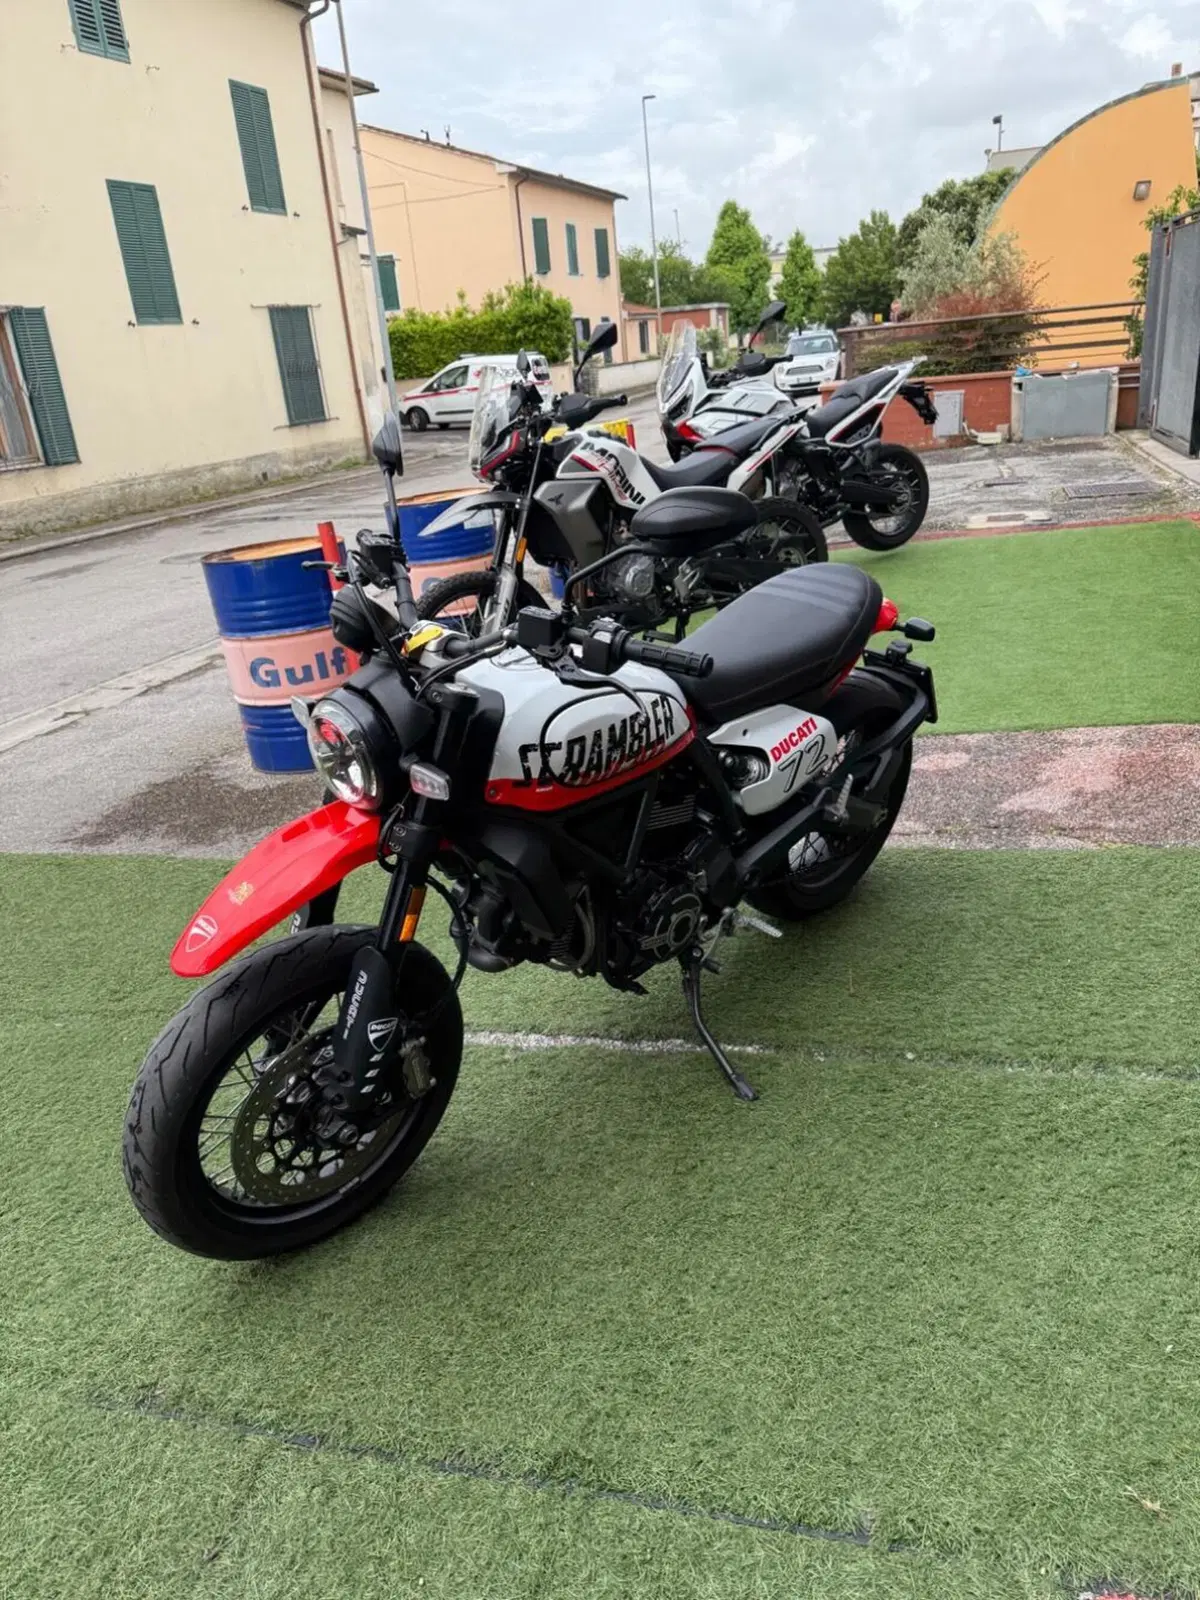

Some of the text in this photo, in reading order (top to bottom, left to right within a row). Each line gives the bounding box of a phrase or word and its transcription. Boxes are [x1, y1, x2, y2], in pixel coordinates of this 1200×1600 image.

[250, 647, 346, 688] Gulf
[512, 694, 675, 787] SCRAMBLER
[770, 716, 818, 763] DUCATI
[778, 733, 828, 793] 72
